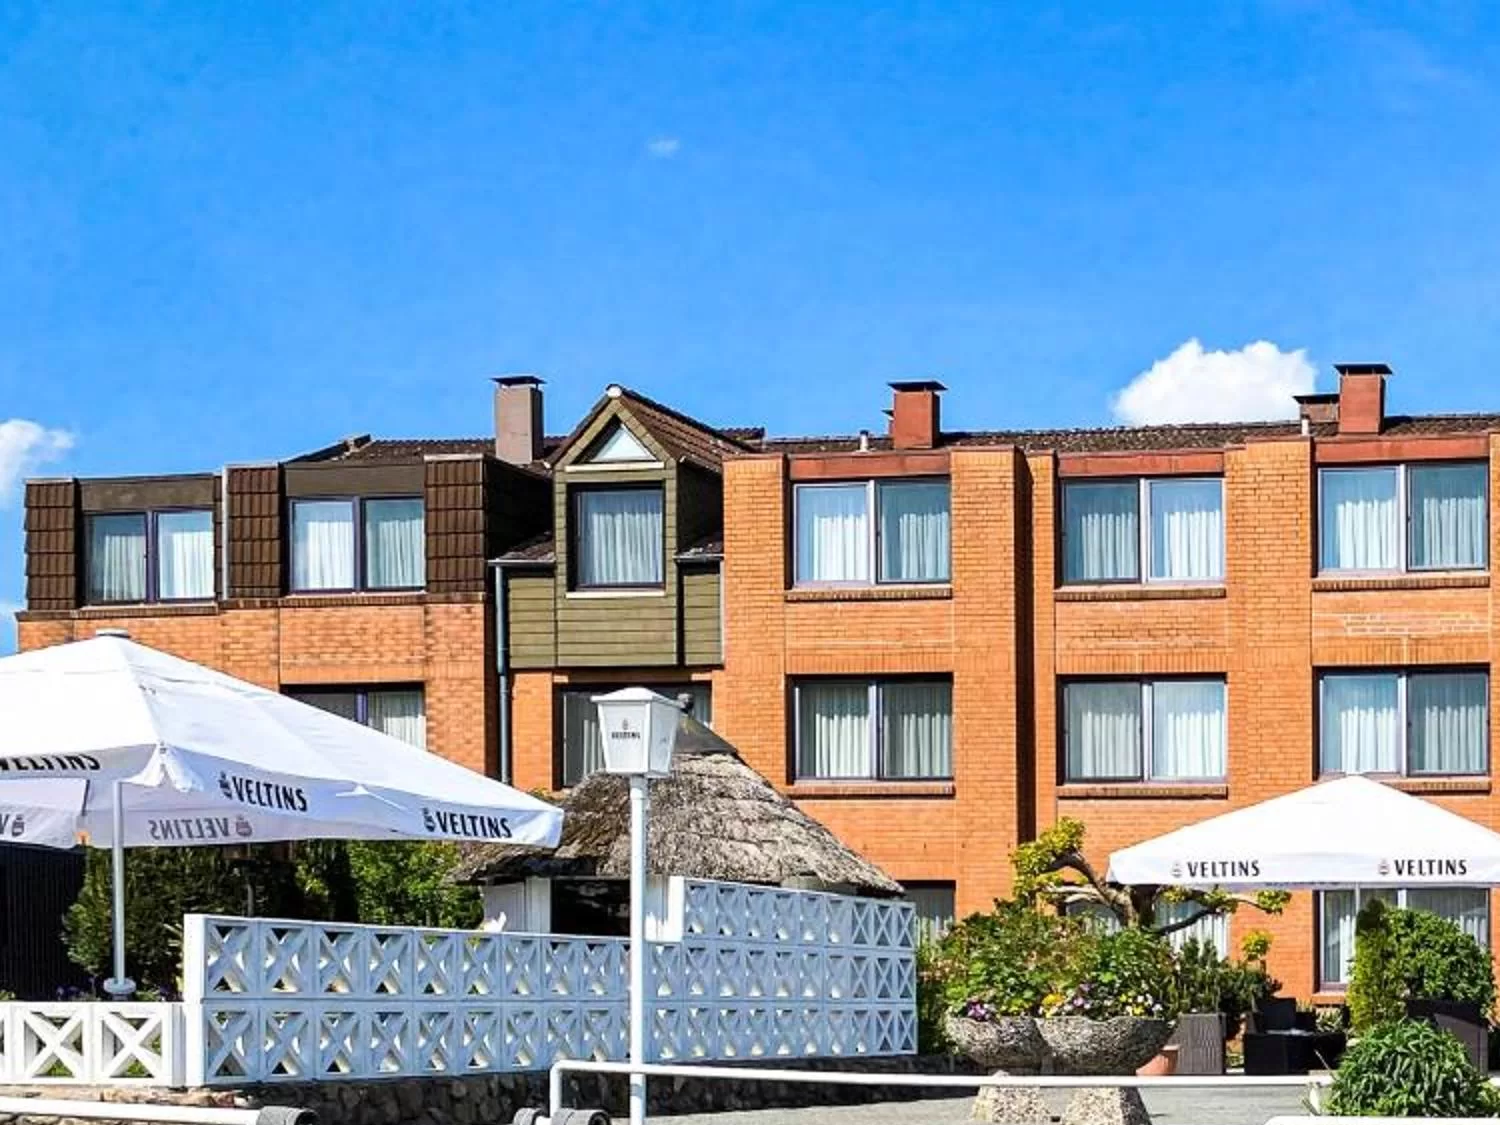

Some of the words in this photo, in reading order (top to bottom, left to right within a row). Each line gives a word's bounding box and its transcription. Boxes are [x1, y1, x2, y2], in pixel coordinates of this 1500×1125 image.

[231, 775, 308, 813] VELTINS
[435, 811, 512, 839] VELTINS
[1187, 859, 1261, 878] VELTINS
[1394, 859, 1468, 876] VELTINS
